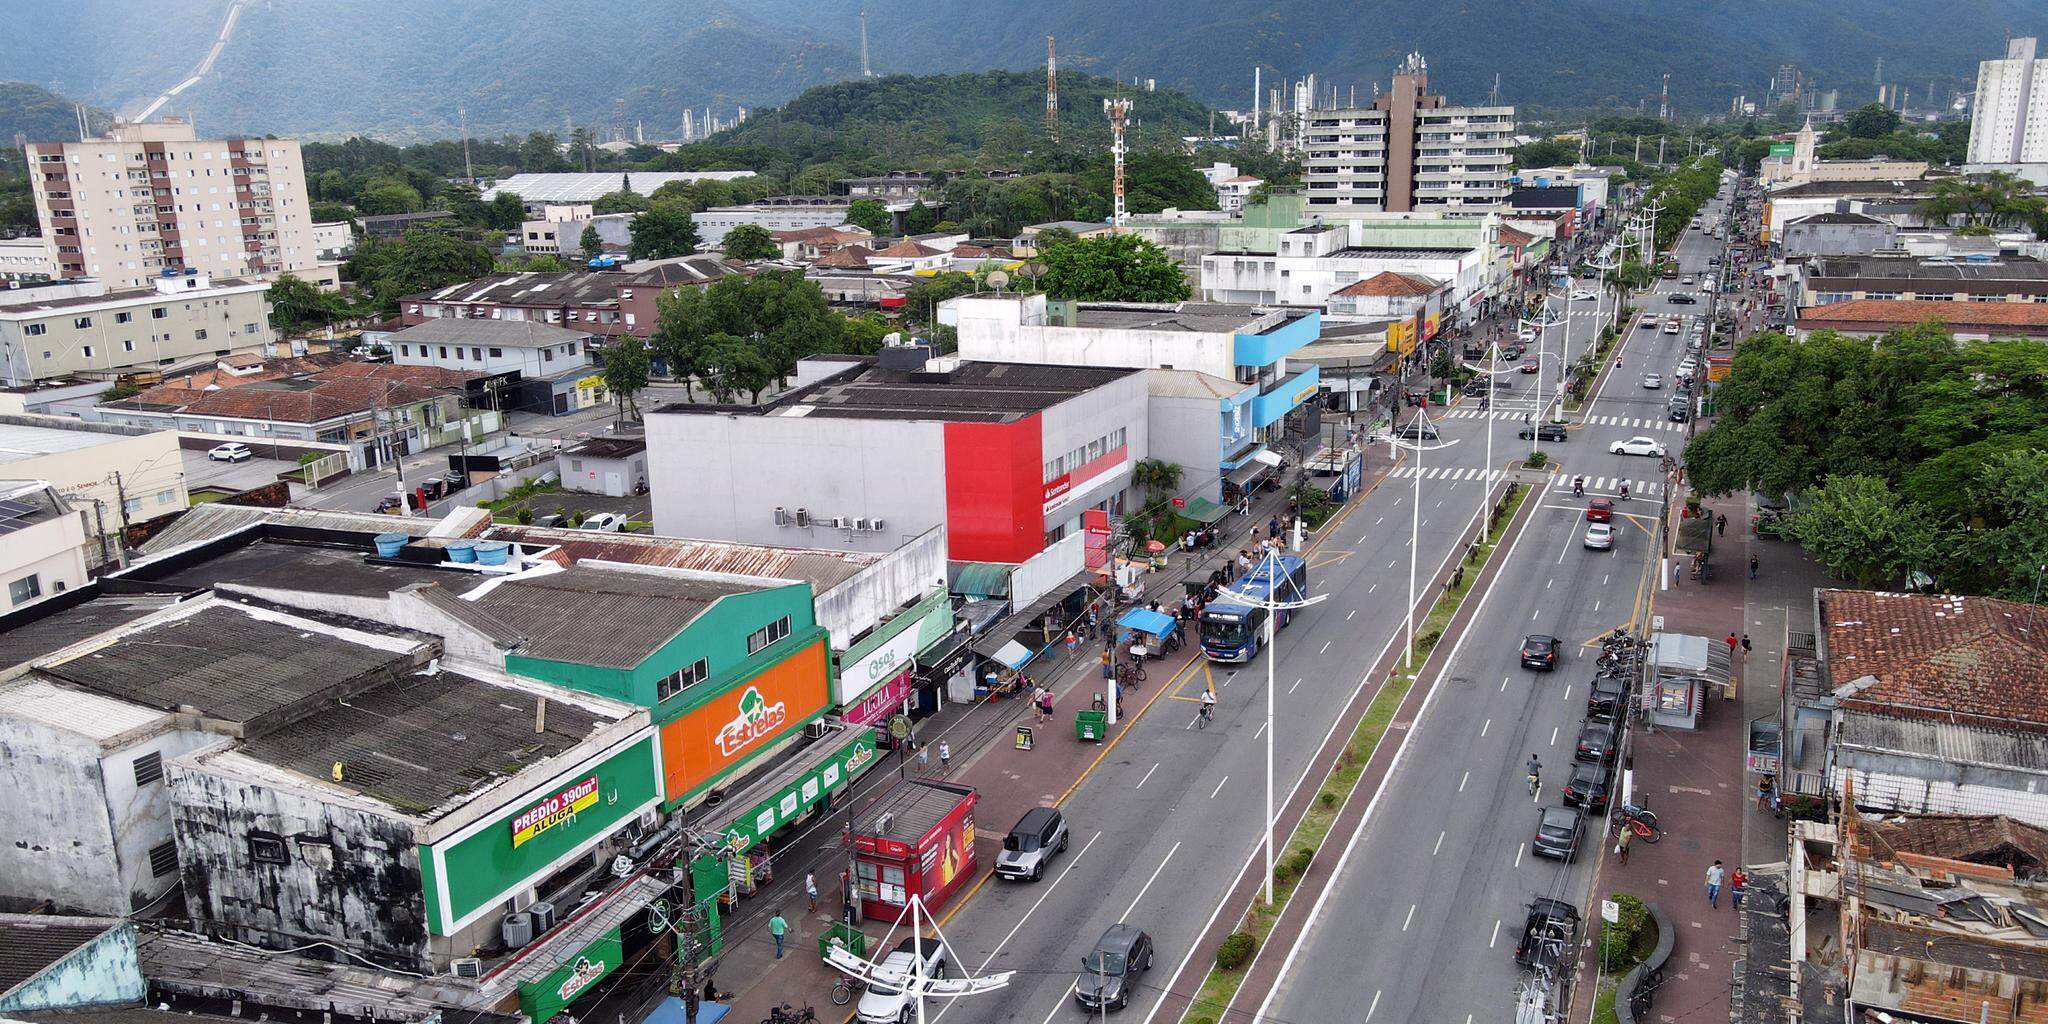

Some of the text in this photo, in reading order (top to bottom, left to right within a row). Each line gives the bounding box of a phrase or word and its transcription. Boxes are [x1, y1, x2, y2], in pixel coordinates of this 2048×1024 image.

[1050, 481, 1070, 496] Santander
[863, 686, 890, 717] LUCILA
[720, 704, 785, 753] Estrelas
[514, 777, 596, 833] PRÉDIO 390m²
[533, 806, 574, 835] ALUGA
[560, 961, 604, 1000] Estrelas
